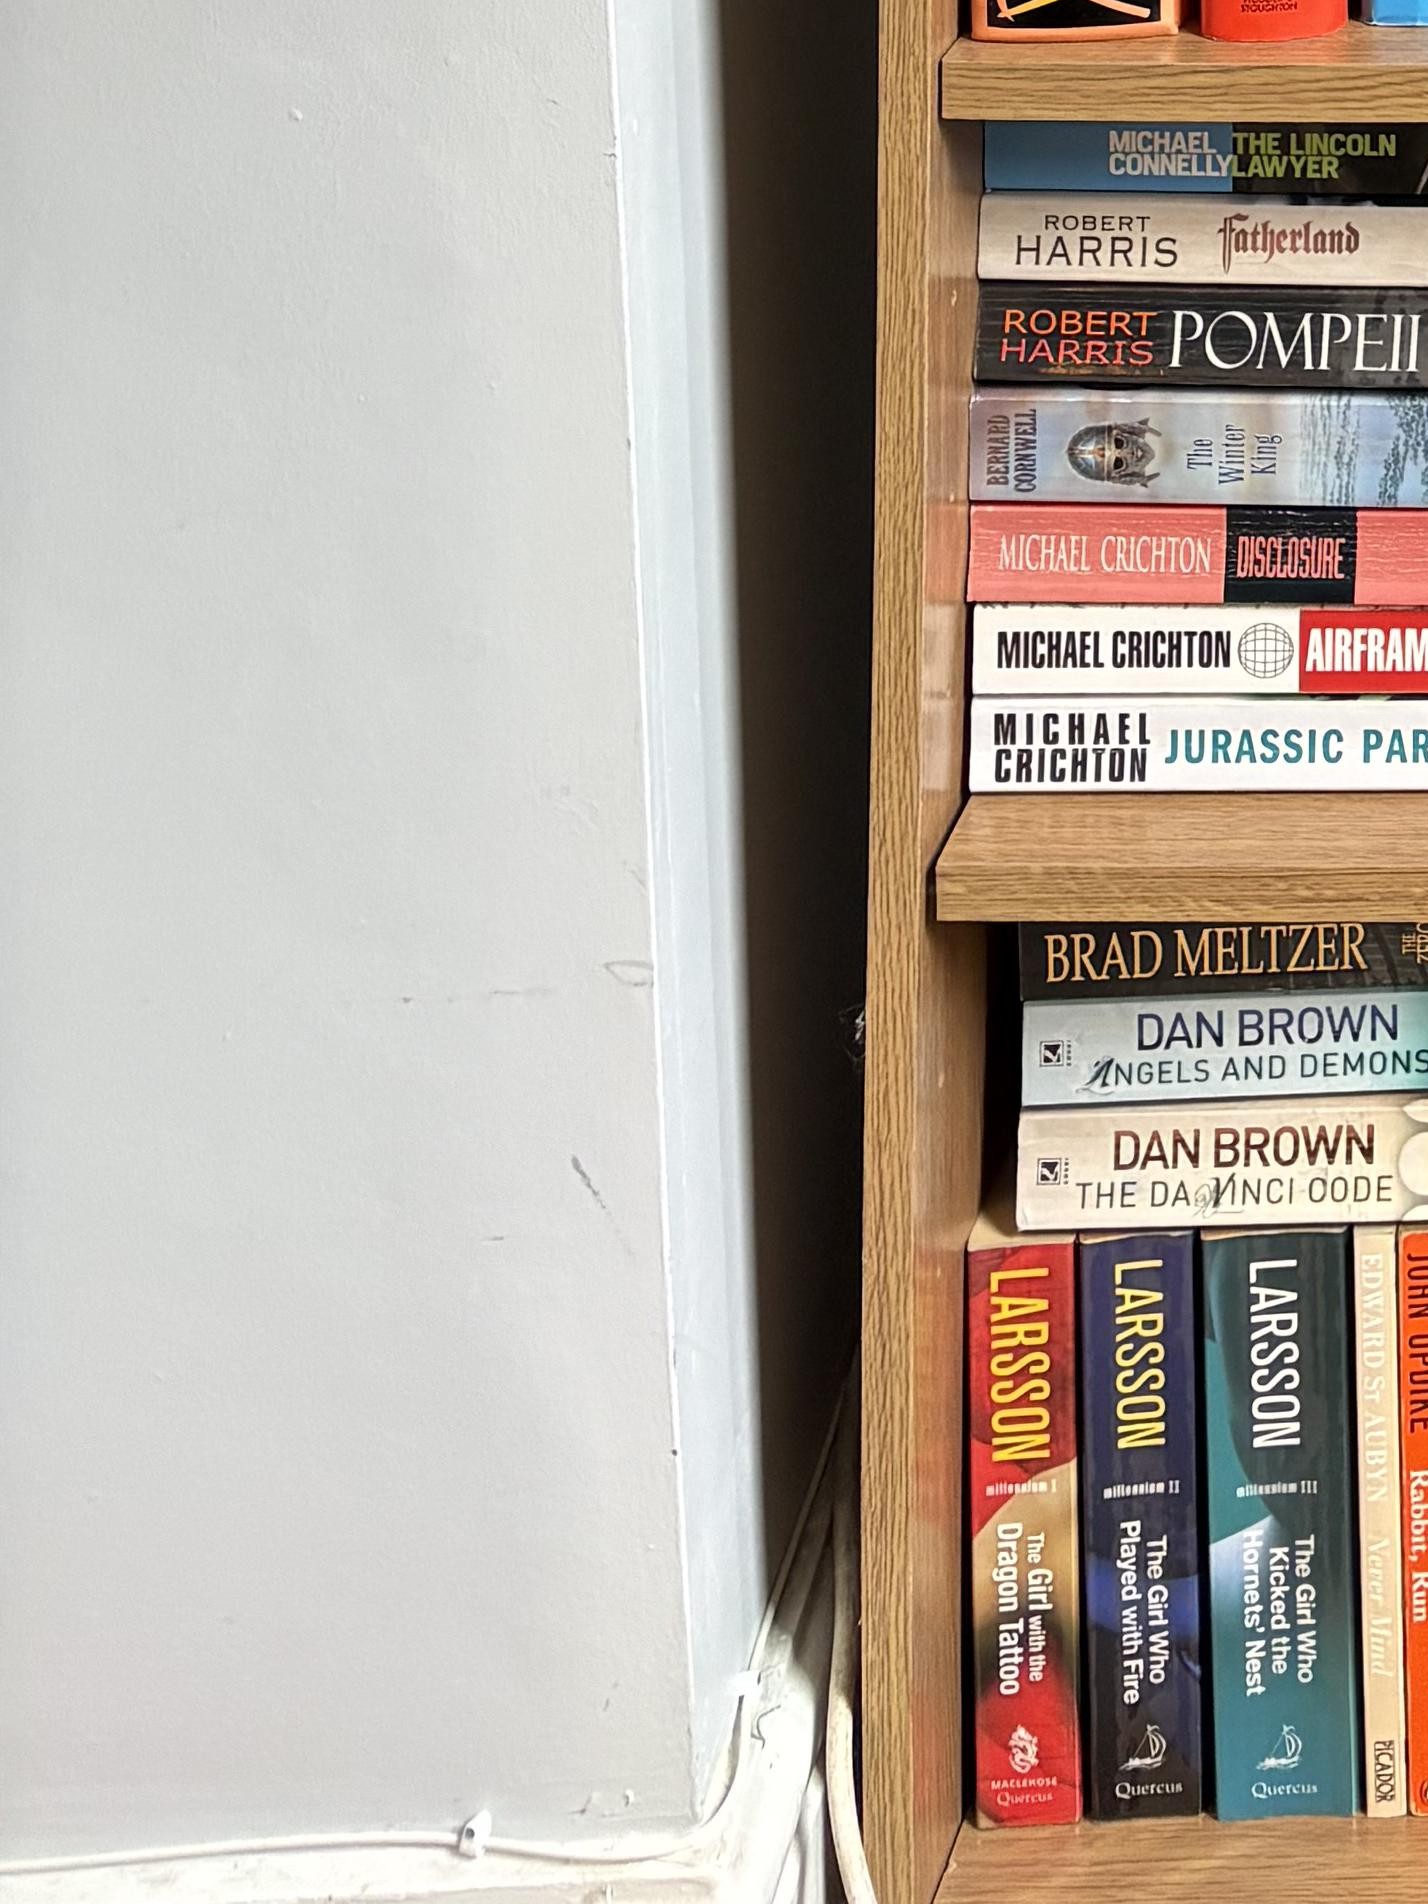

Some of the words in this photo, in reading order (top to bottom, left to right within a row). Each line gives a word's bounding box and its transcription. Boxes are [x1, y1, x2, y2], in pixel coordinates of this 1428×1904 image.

[1003, 309, 1157, 336] ROBERT
[1170, 310, 1422, 374] POMPEII
[999, 338, 1154, 364] HARRIS
[994, 713, 1151, 746] MICHAEL
[1164, 728, 1344, 765] JURASSIC
[994, 748, 1147, 784] CRICHTON
[1137, 1011, 1225, 1050] DAN
[1238, 1004, 1399, 1048] BROWN
[990, 1267, 1051, 1462] LARSSON
[1114, 1259, 1164, 1449] LARSSON
[1249, 1259, 1300, 1448] LARSSON
